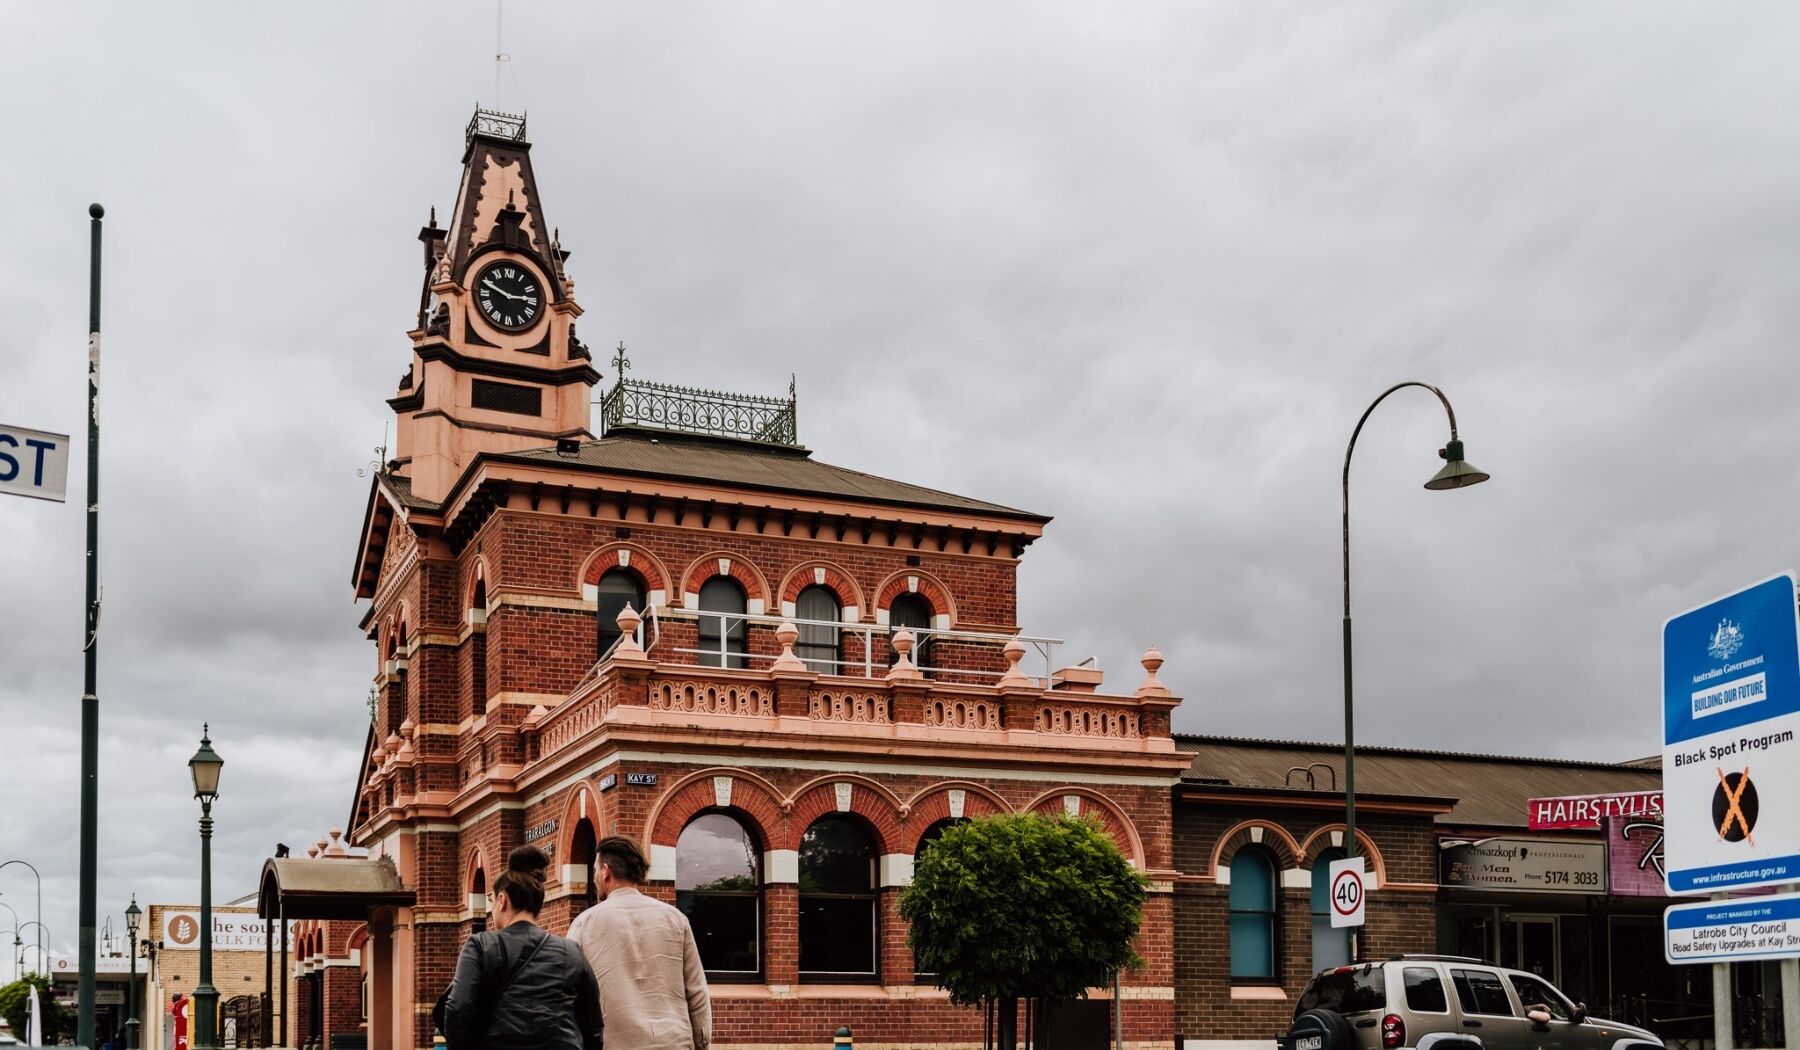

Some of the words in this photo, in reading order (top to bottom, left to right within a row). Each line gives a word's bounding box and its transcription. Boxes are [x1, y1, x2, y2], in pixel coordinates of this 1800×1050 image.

[0, 434, 56, 486] ST
[1692, 667, 1723, 684] Australian
[1723, 655, 1764, 674] Government
[1694, 692, 1723, 712] BUILDING
[1723, 688, 1738, 704] OUR
[1738, 680, 1764, 700] FUTURE
[1675, 749, 1706, 767] Black
[1709, 742, 1736, 760] Spot
[1740, 730, 1793, 751] Program
[628, 774, 644, 782] KAY
[1537, 795, 1664, 824] HAIRSTYLIS
[1481, 864, 1510, 873] Men
[1692, 866, 1787, 884] www.infrastructure.gov.au
[1544, 871, 1569, 884] 5174
[1573, 871, 1598, 885] 3033
[1336, 881, 1358, 904] 40
[1706, 912, 1728, 920] PROJECT
[1728, 910, 1754, 919] MANAGED
[213, 917, 233, 933] he
[1692, 928, 1727, 940] Latrobe
[1729, 925, 1748, 938] City
[1751, 922, 1787, 935] Council
[212, 935, 243, 945] ULK
[1673, 943, 1691, 953] Road
[1693, 941, 1717, 953] Safety
[1718, 938, 1756, 952] Upgrades
[1758, 938, 1767, 947] at
[1768, 937, 1784, 948] Kay
[1786, 935, 1800, 945] Str
